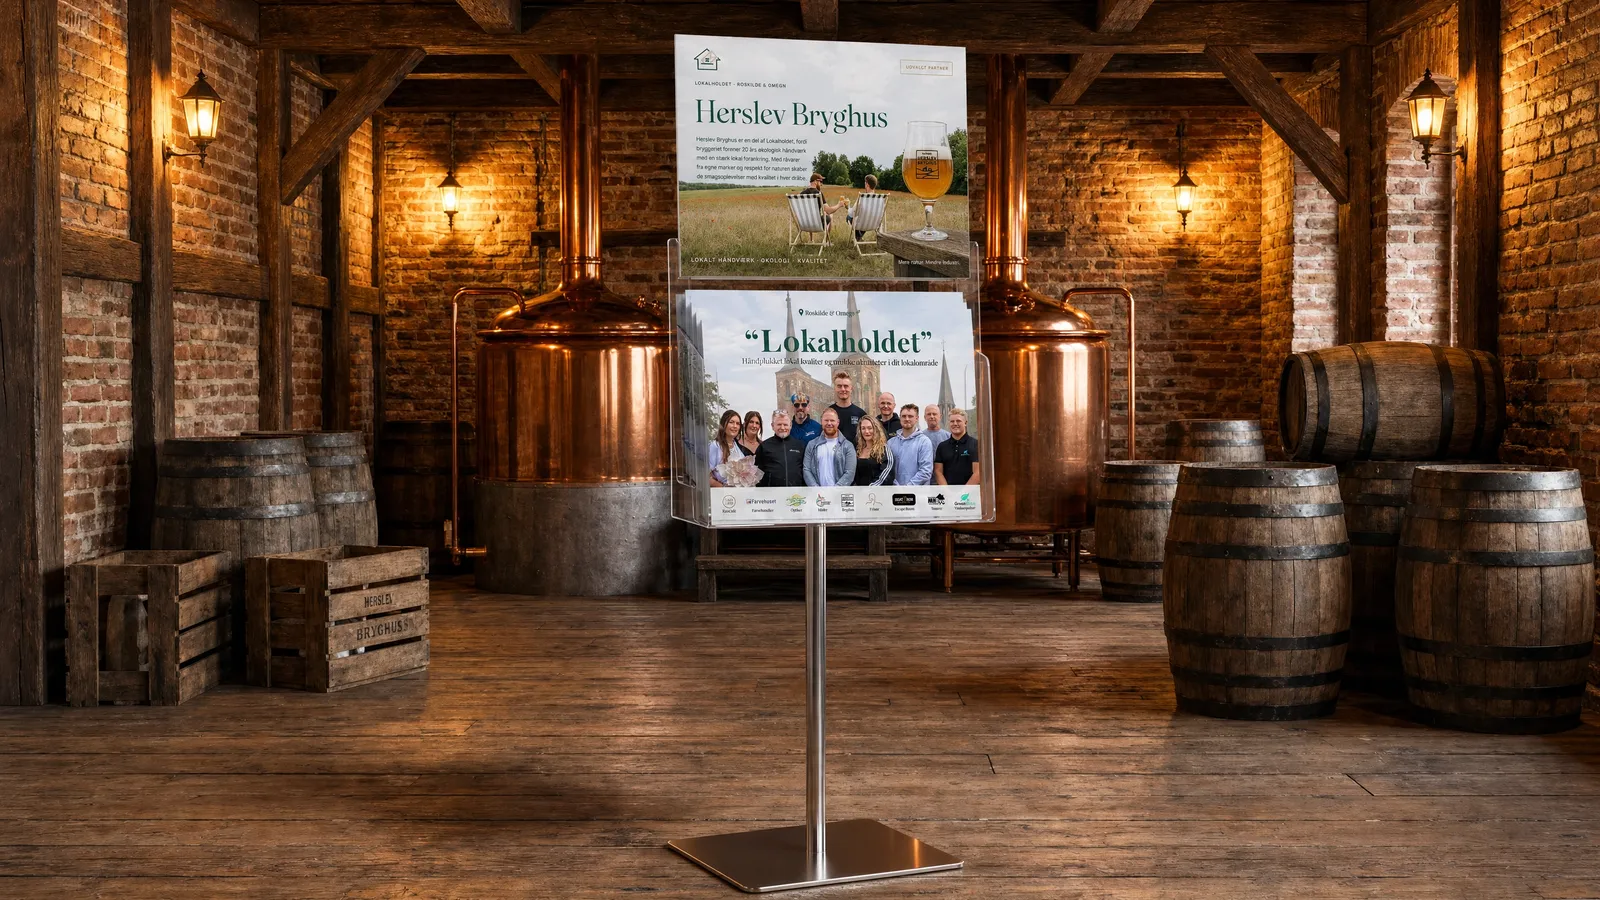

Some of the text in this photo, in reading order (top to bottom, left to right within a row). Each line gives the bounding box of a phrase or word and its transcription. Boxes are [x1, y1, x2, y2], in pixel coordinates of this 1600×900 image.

[696, 99, 888, 134] Herslev Bryghus
[742, 357, 782, 366] Håndplukket
[901, 358, 939, 367] lokalområde
